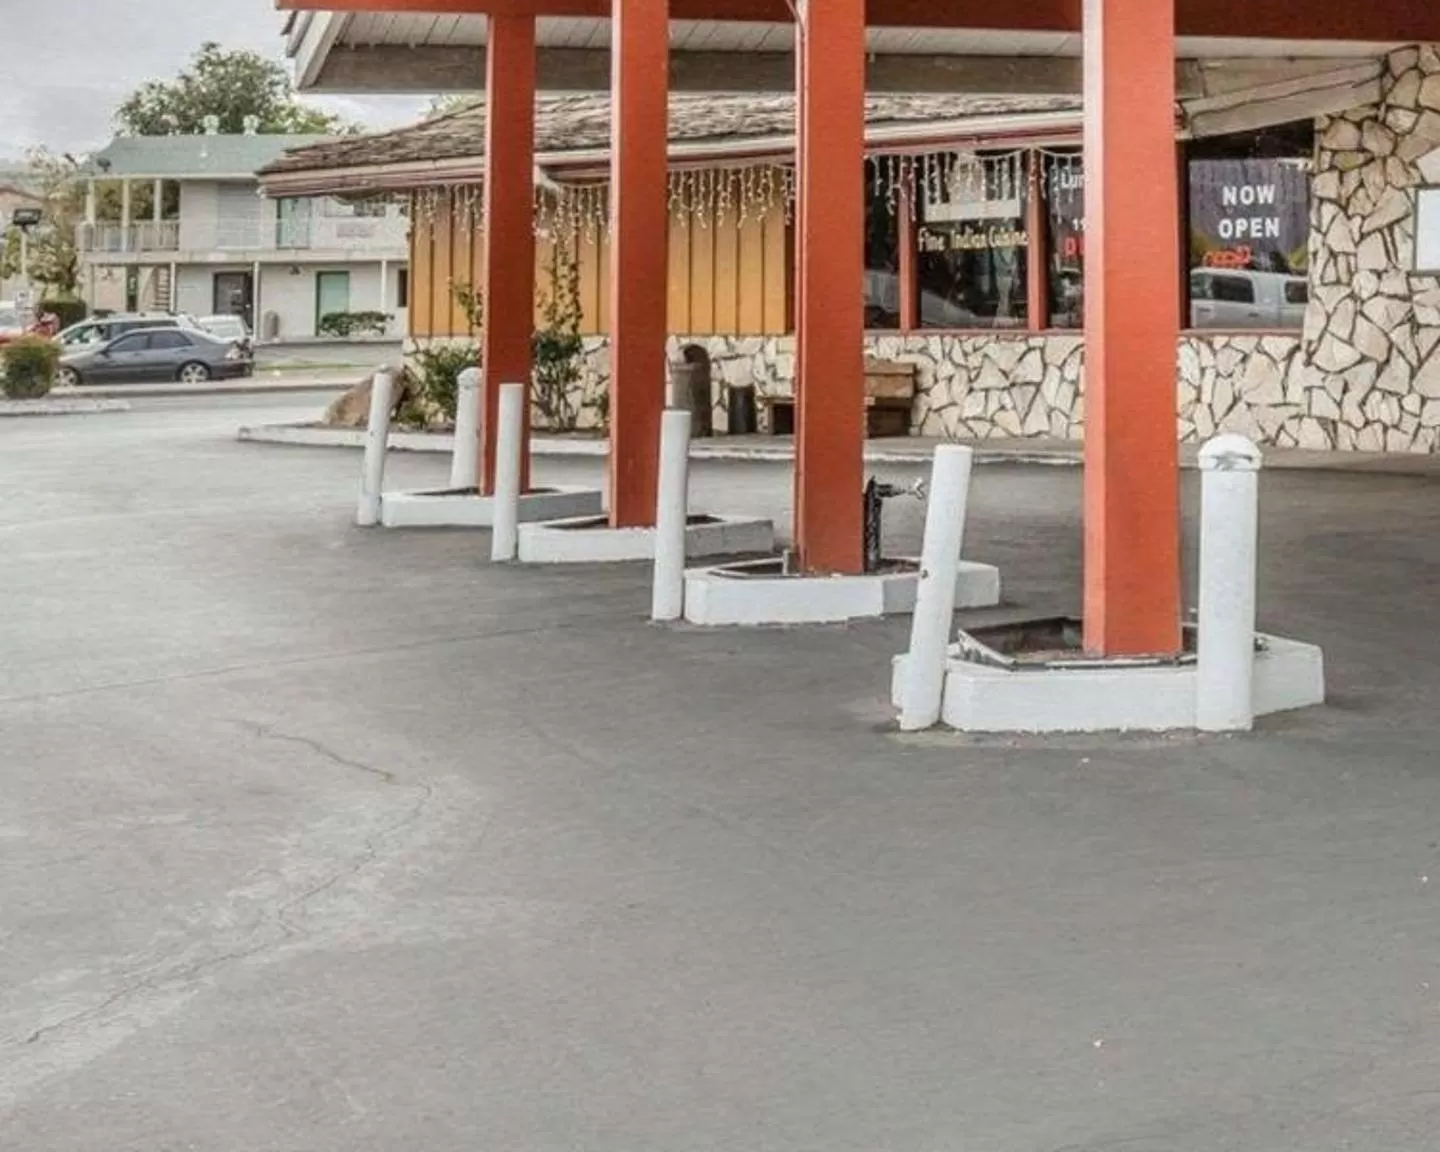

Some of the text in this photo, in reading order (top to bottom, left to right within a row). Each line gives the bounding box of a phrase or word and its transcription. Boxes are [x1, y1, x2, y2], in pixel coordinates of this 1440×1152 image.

[1222, 184, 1276, 206] NOW
[950, 225, 987, 249] Indian
[1218, 217, 1280, 239] OPEN
